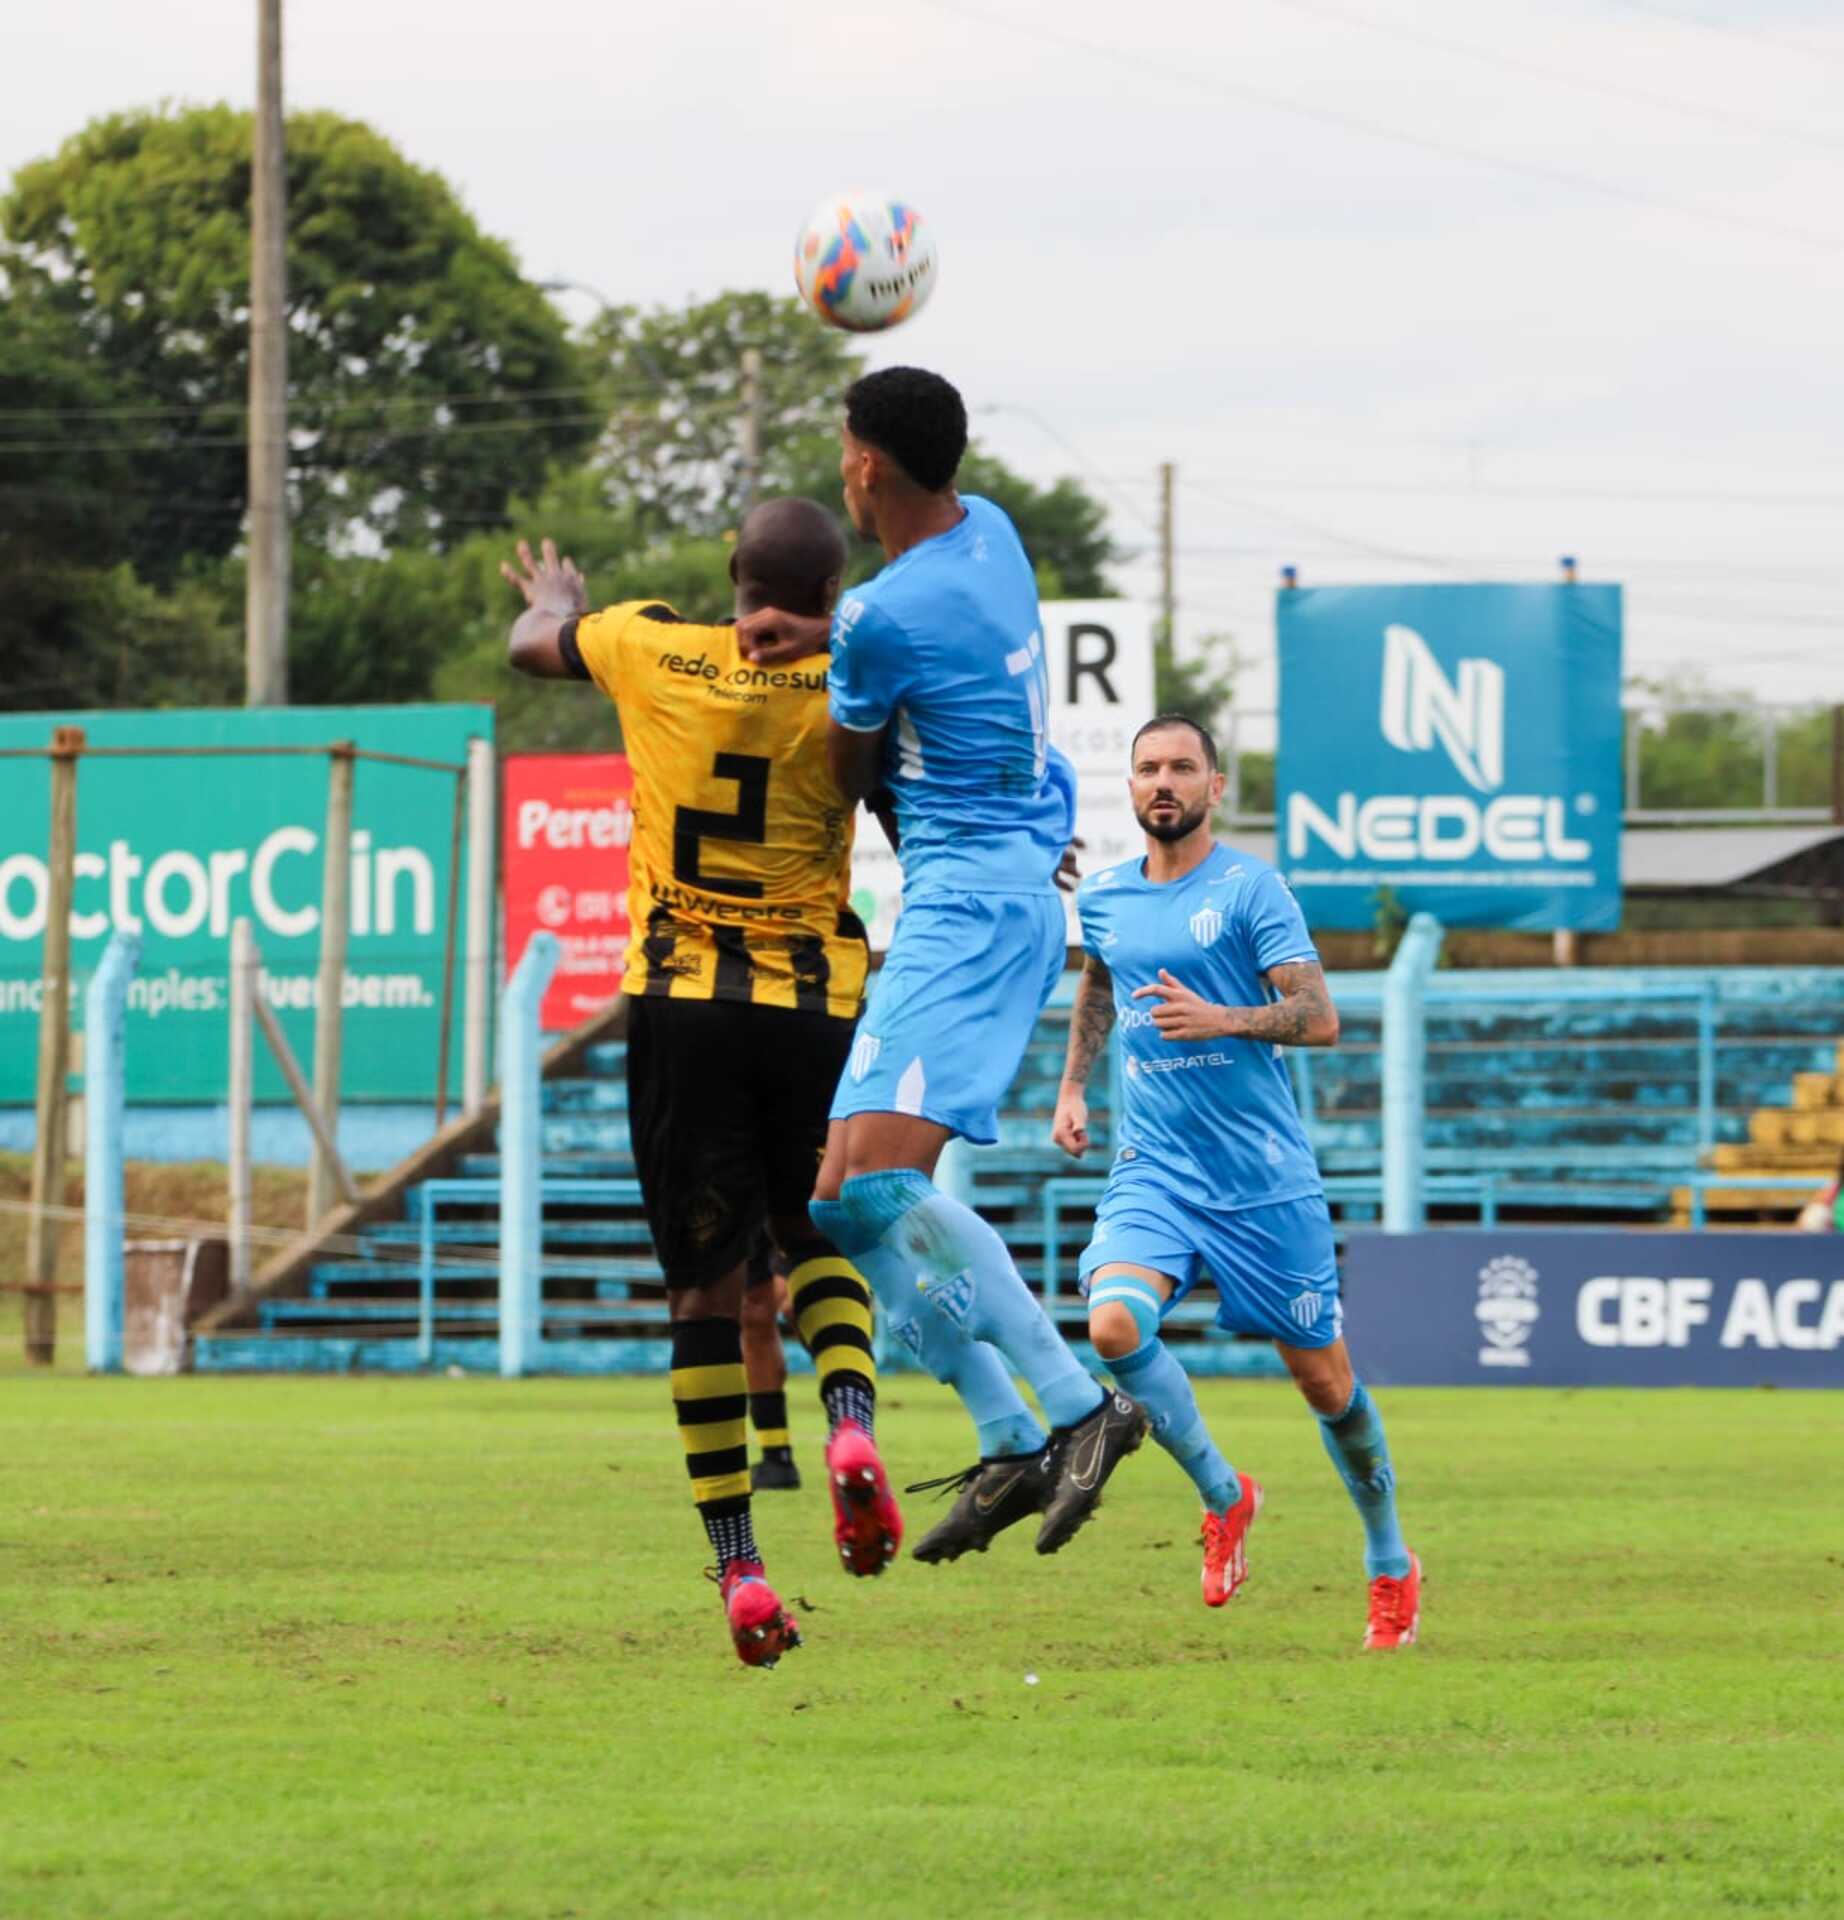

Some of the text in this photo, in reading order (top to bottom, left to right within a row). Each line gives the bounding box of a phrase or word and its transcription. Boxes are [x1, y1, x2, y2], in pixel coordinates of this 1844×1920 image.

[658, 652, 720, 681] rede
[706, 684, 768, 704] Telecom
[1066, 623, 1119, 704] R
[674, 753, 770, 899] 2
[1287, 791, 1592, 862] NEDEL
[0, 826, 434, 940] octorCin
[1576, 1276, 1712, 1348] CBF
